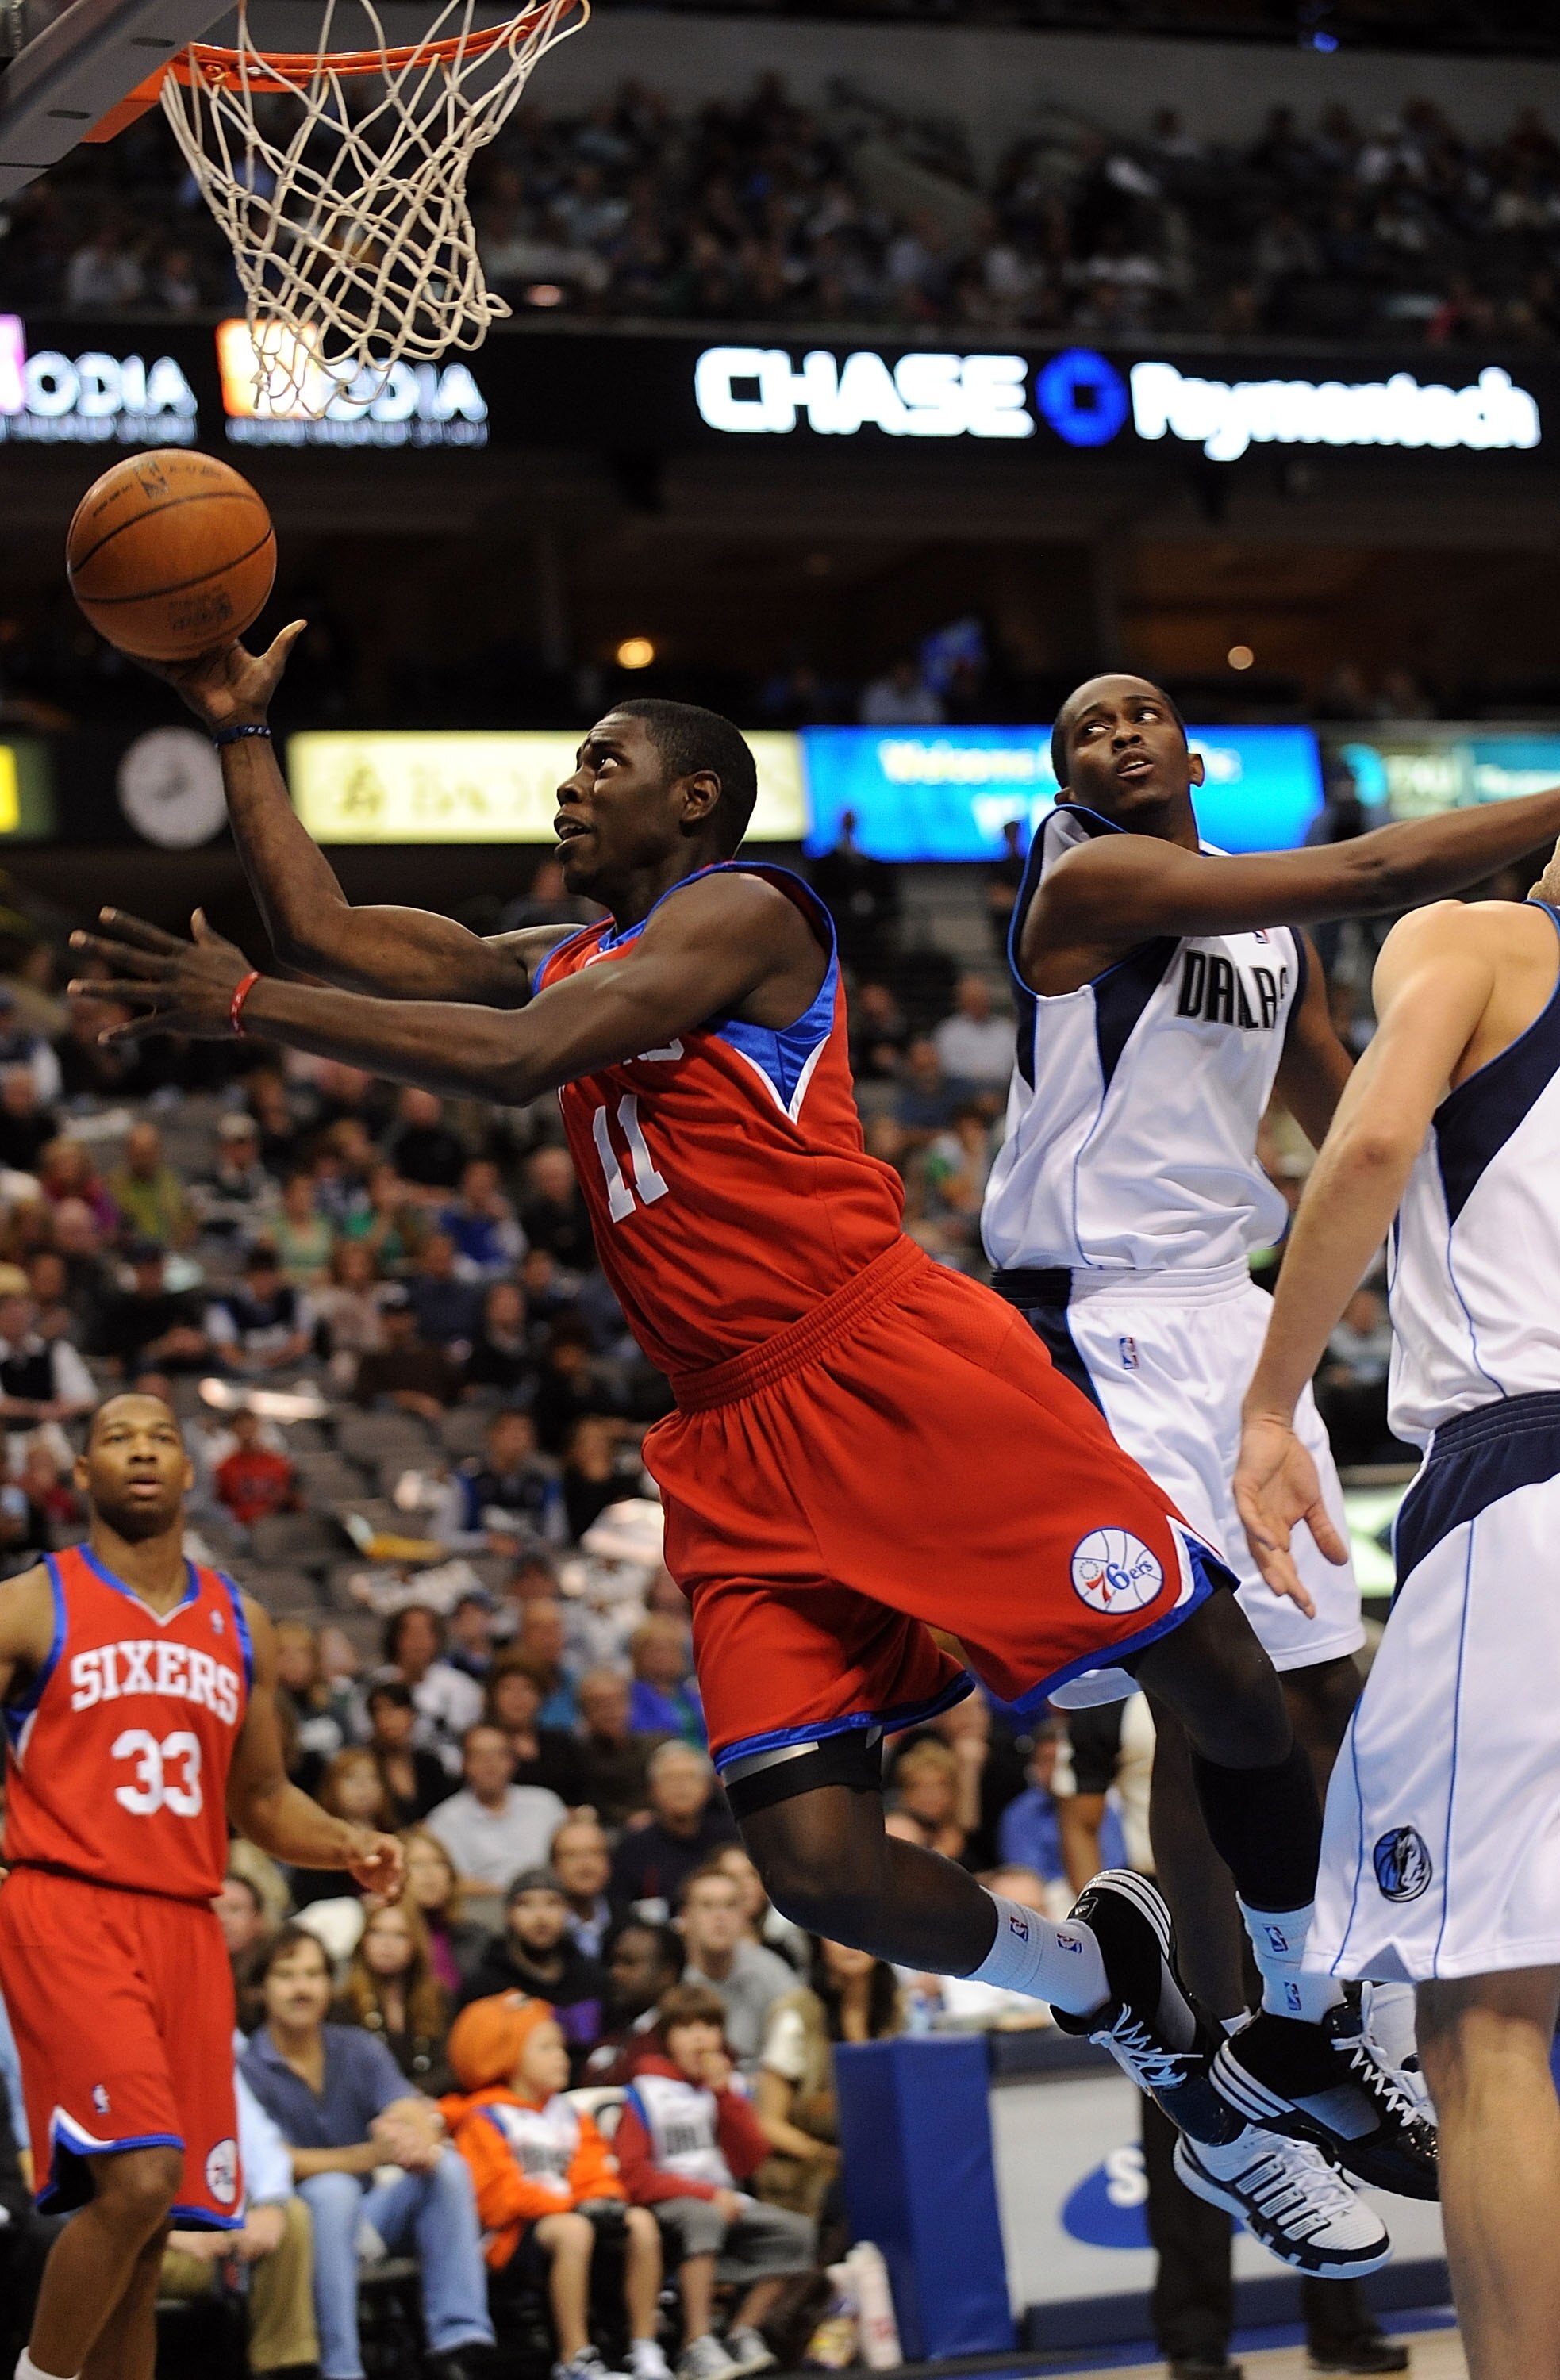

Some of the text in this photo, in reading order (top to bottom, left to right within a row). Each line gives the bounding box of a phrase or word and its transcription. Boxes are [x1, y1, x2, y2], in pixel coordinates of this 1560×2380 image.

[694, 347, 1036, 437] CHASE
[592, 1094, 669, 1223] 11
[71, 1639, 239, 1726] SIXERS
[111, 1729, 202, 1818] 33
